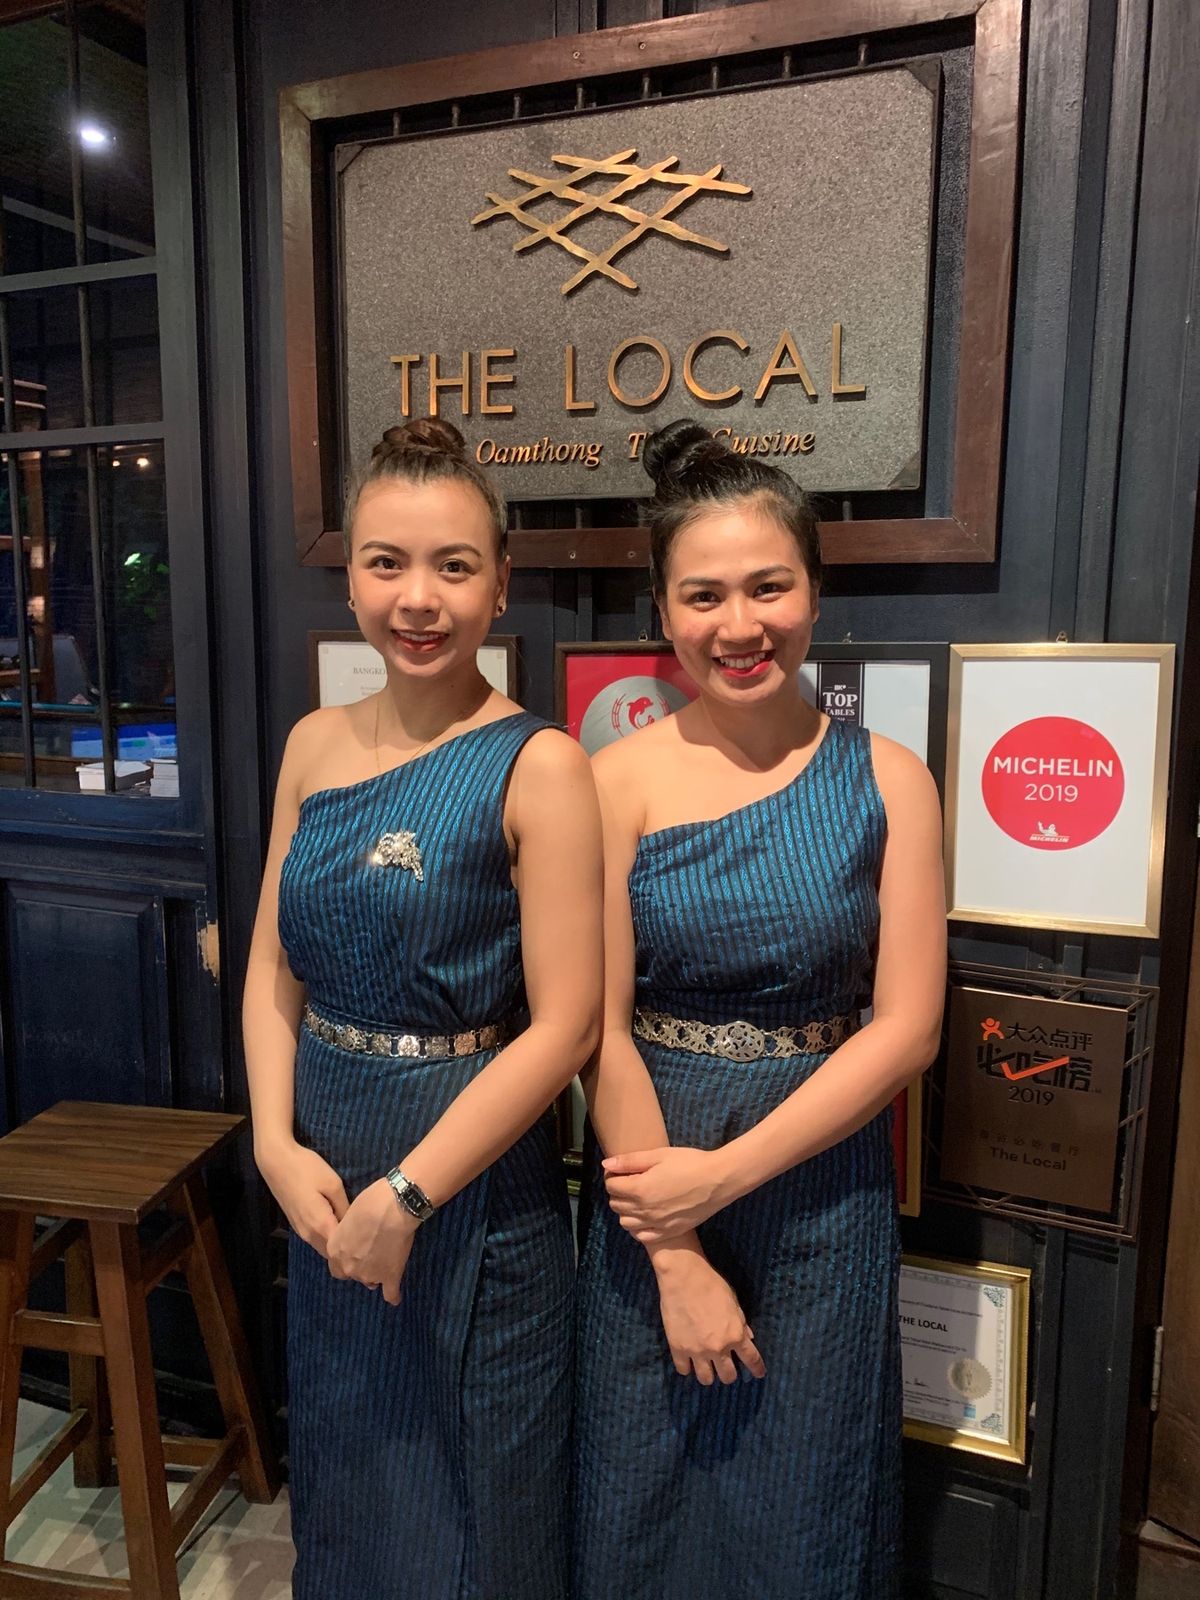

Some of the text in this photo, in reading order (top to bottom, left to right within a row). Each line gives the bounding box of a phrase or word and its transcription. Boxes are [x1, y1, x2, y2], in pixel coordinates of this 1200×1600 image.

[390, 323, 867, 417] THE LOCAL
[475, 438, 603, 469] Oamthong
[354, 667, 386, 675] BANGKO
[822, 692, 858, 707] TOP
[825, 707, 855, 716] TABLES
[993, 756, 1114, 778] MICHELIN
[1024, 783, 1079, 803] 2019
[1006, 1022, 1094, 1051] 大众点评
[1008, 1085, 1055, 1106] 2019
[990, 1146, 1067, 1171] The Local
[898, 1315, 948, 1331] THE LOCAL
